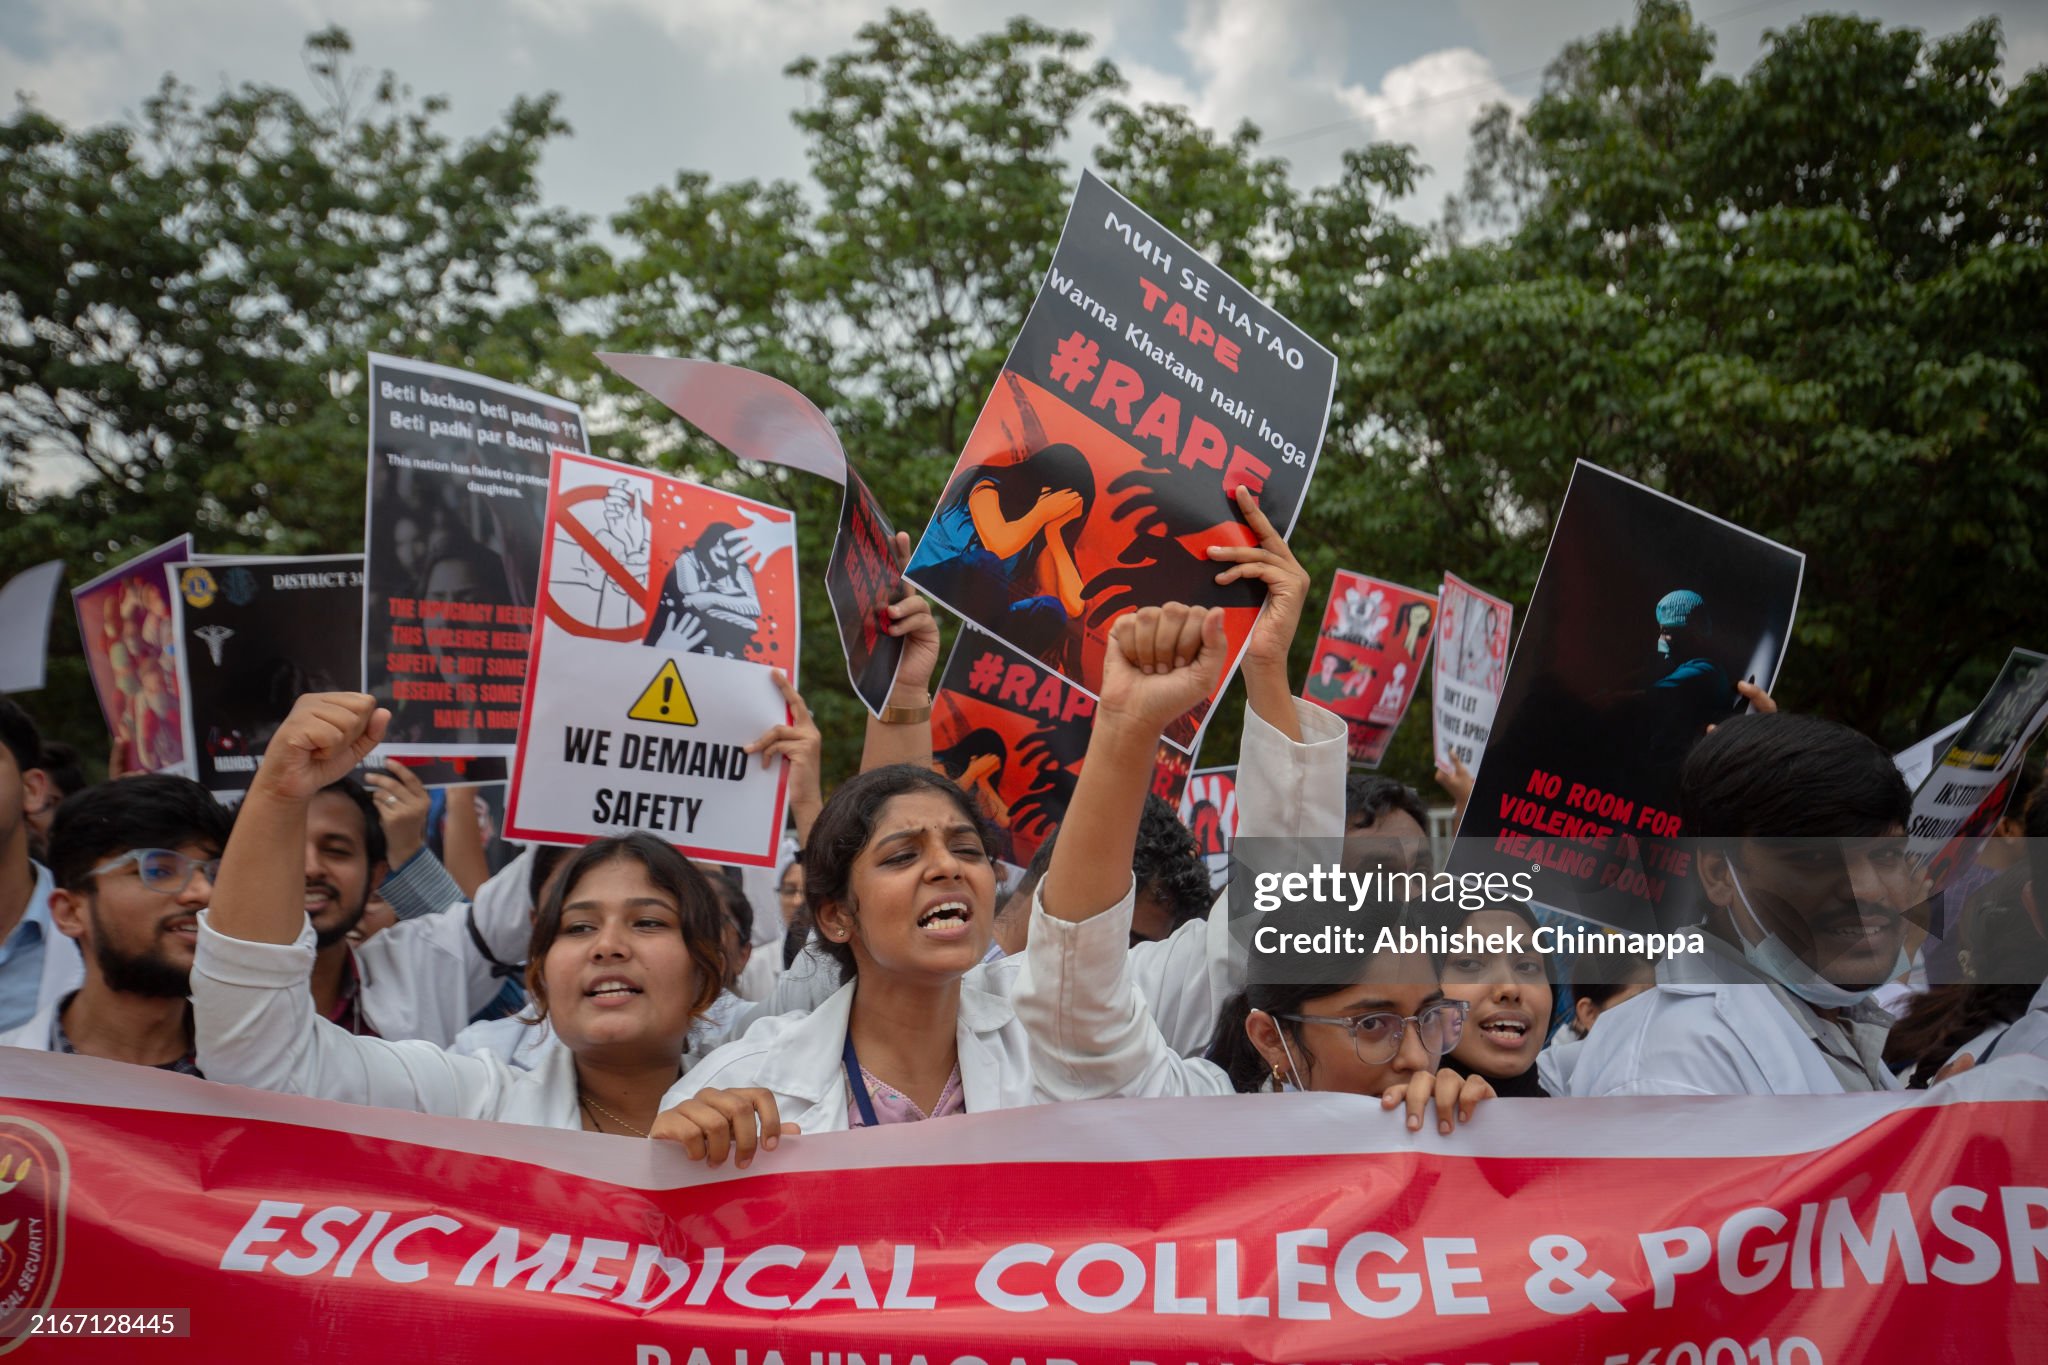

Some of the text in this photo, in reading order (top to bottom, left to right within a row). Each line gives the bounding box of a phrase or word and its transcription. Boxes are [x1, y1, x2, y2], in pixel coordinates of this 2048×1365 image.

[1104, 212, 1304, 370] MUH SE HATAO
[1139, 276, 1242, 373] TAPE
[1050, 268, 1306, 468] Warna Khatam nahi hoga
[381, 380, 416, 402] Beti
[420, 387, 476, 414] bachao
[480, 399, 509, 421] beti
[511, 410, 559, 433] padhao
[389, 411, 425, 432] Beti
[429, 419, 474, 440] padhi
[477, 428, 502, 446] par
[506, 431, 543, 454] Bachi
[1049, 331, 1272, 507] #RAPE
[386, 454, 412, 468] This
[413, 457, 449, 473] nation
[451, 461, 470, 475] has
[471, 464, 501, 479] failed
[502, 470, 513, 482] to
[272, 572, 346, 590] DISTRICT
[388, 597, 416, 619] THE
[386, 653, 436, 674] SAFETY
[458, 656, 484, 676] NOT
[391, 626, 423, 646] THIS
[425, 628, 489, 650] VIOLENCE
[392, 680, 453, 702] DESERVE
[968, 651, 1098, 724] #RAP
[433, 709, 471, 729] HAVE
[473, 710, 484, 729] A
[563, 725, 749, 782] WE DEMAND
[592, 788, 702, 833] SAFETY
[1526, 769, 1682, 839] NO ROOM FOR
[1499, 793, 1691, 878] VIOLENCE IN THE
[1494, 828, 1667, 904] HEALING ROOM
[18, 1217, 43, 1292] SECURITY
[219, 1185, 2048, 1320] ESIC MEDICAL COLLEGE & PGIMSR
